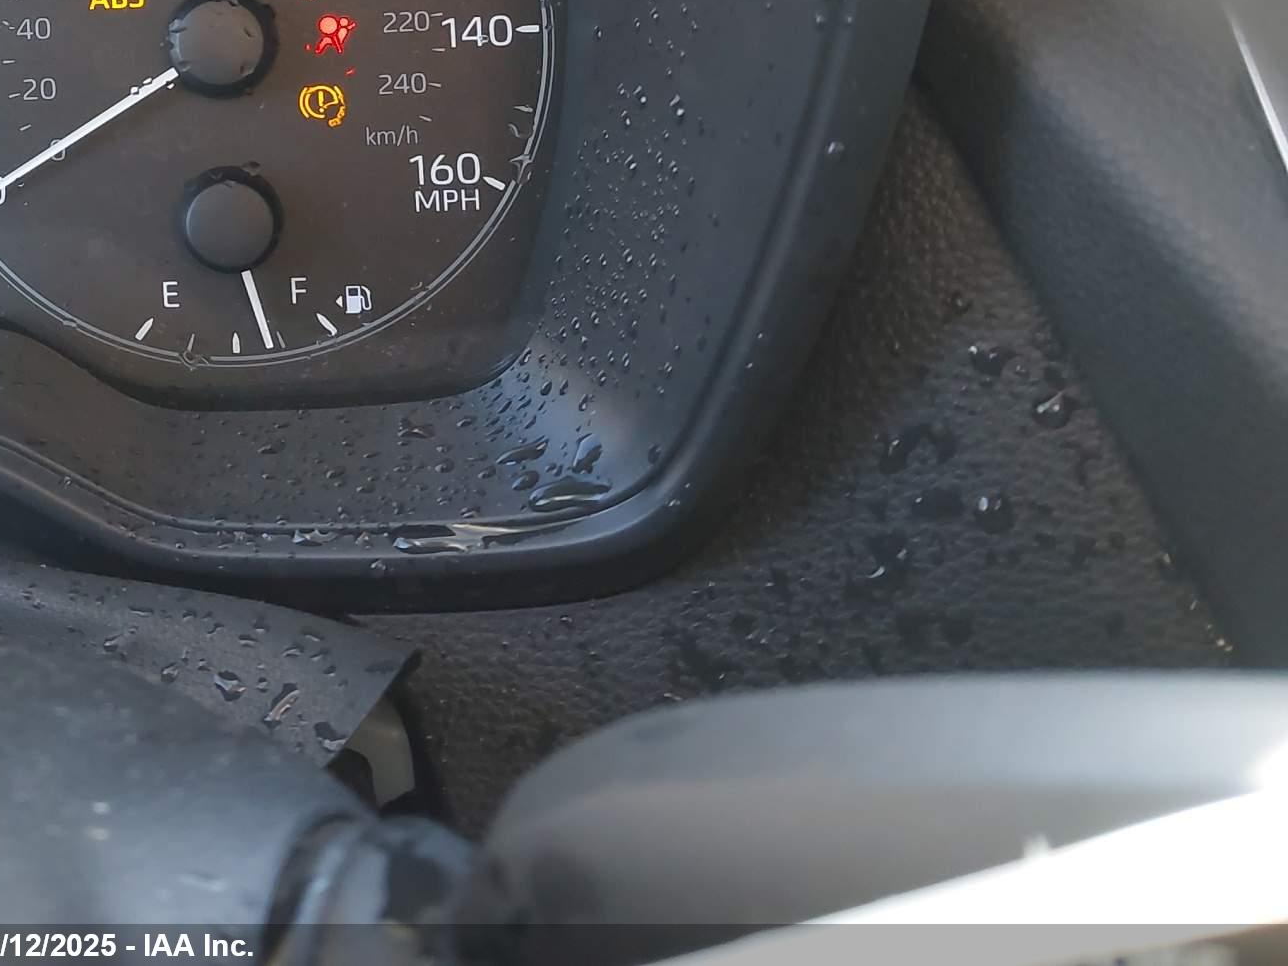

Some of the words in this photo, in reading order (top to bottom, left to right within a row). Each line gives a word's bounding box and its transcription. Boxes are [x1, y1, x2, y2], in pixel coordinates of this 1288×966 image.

[16, 18, 51, 40] 40
[384, 11, 429, 32] 220
[442, 15, 512, 48] 140
[22, 78, 56, 101] 20
[379, 73, 426, 95] 240
[366, 125, 418, 146] km/h
[409, 153, 480, 185] 160
[415, 188, 480, 212] MPH
[163, 281, 179, 307] E
[290, 277, 306, 303] F
